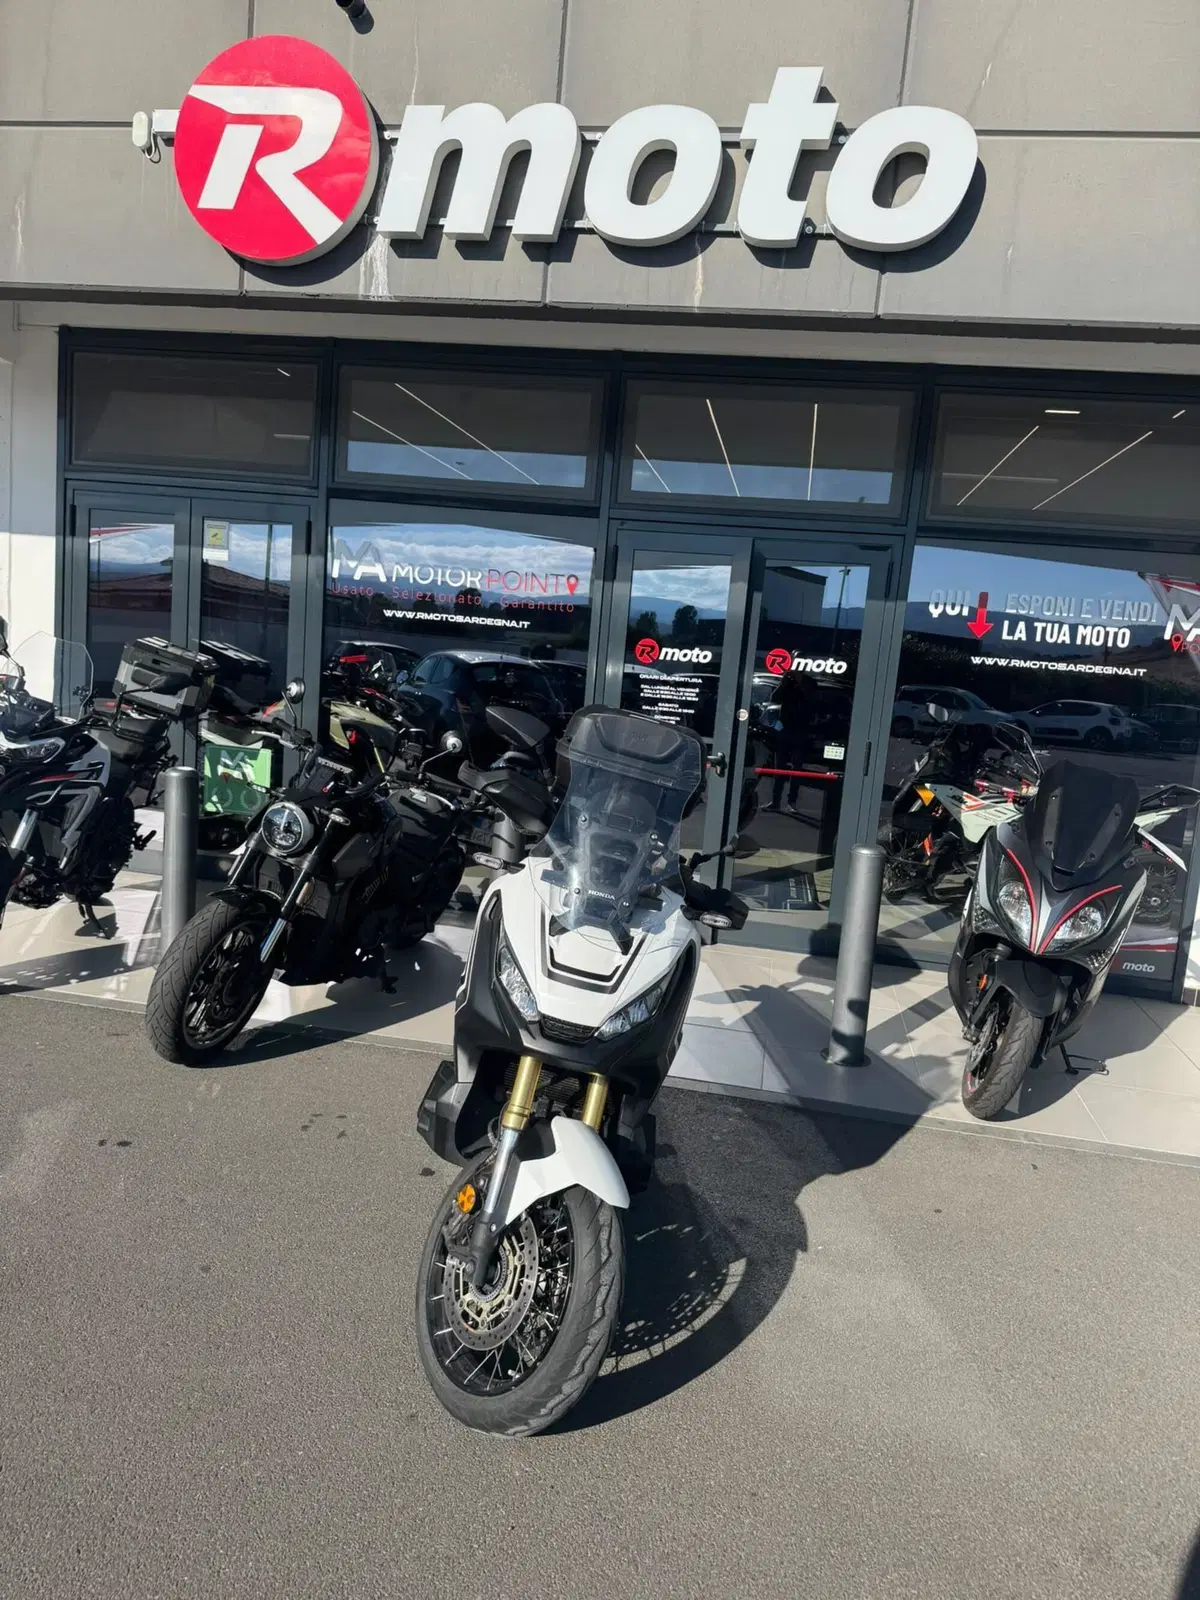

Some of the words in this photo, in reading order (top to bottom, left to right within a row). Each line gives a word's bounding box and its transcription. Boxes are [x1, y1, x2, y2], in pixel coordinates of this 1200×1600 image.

[376, 66, 979, 250] moto
[391, 563, 483, 589] MOTOR
[486, 568, 566, 594] POINT
[331, 582, 374, 598] Usato
[391, 587, 482, 606] Selezionato
[499, 594, 575, 614] Garantito
[928, 588, 971, 618] QUI
[1004, 592, 1075, 617] ESPONI
[1080, 598, 1093, 618] E
[1099, 599, 1158, 622] VENDI
[383, 608, 531, 630] WWW.RMOTOSARDEGNA.IT
[1002, 620, 1027, 642] LA
[1034, 622, 1071, 645] TUA
[1076, 625, 1131, 648] MOTO
[659, 648, 712, 664] moto
[792, 657, 847, 675] moto
[970, 656, 1147, 677] WWW.RMOTOSARDEGNA.IT
[588, 889, 615, 900] HONDA
[1122, 962, 1155, 972] moto
